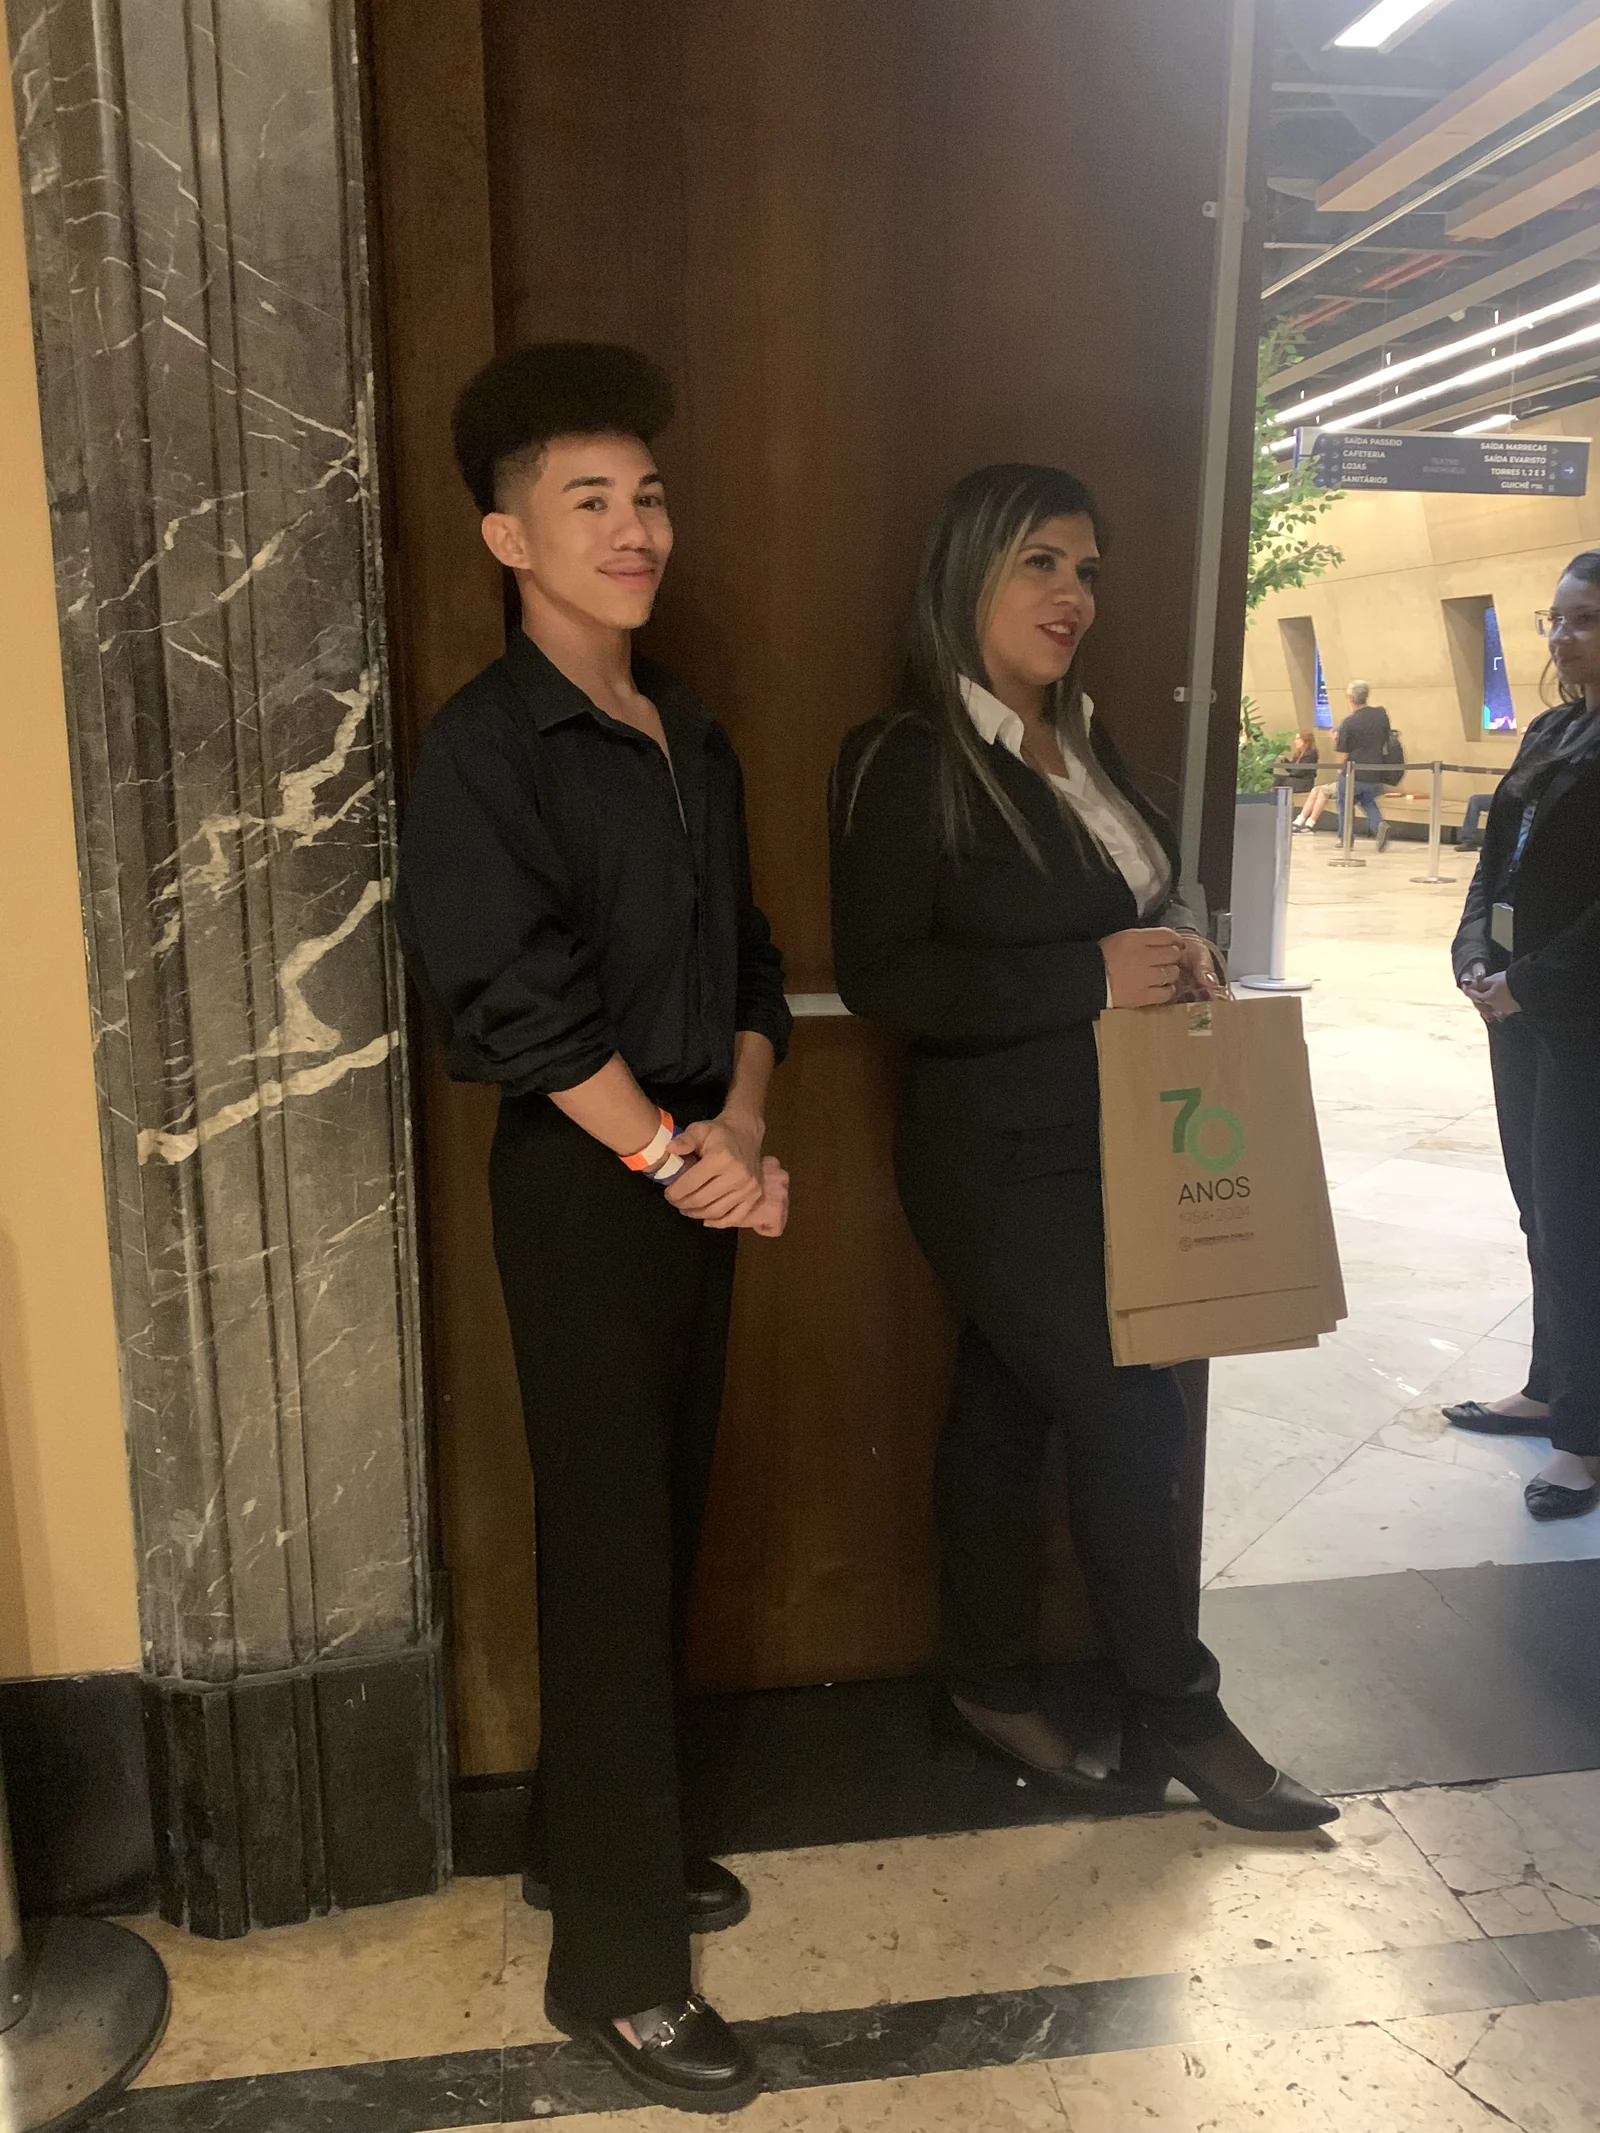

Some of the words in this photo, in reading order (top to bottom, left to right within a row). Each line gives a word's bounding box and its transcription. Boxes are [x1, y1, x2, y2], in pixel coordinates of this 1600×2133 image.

[1344, 436, 1369, 445] SAÍDA
[1369, 438, 1403, 447] PASSEIO
[1480, 441, 1505, 450] SAÍDA
[1505, 443, 1548, 452] MARRECAS
[1342, 449, 1386, 459] CAFETERIA
[1484, 454, 1508, 463] SAÍDA
[1509, 456, 1547, 464] EVARISTO
[1342, 462, 1367, 471] LOJAS
[1490, 467, 1520, 476] TORRES
[1528, 469, 1534, 477] 2
[1534, 469, 1540, 477] E
[1540, 469, 1546, 477] 3
[1341, 474, 1388, 485] SANITÁRIOS
[1159, 1087, 1245, 1172] 70
[1178, 1176, 1251, 1205] ANOS
